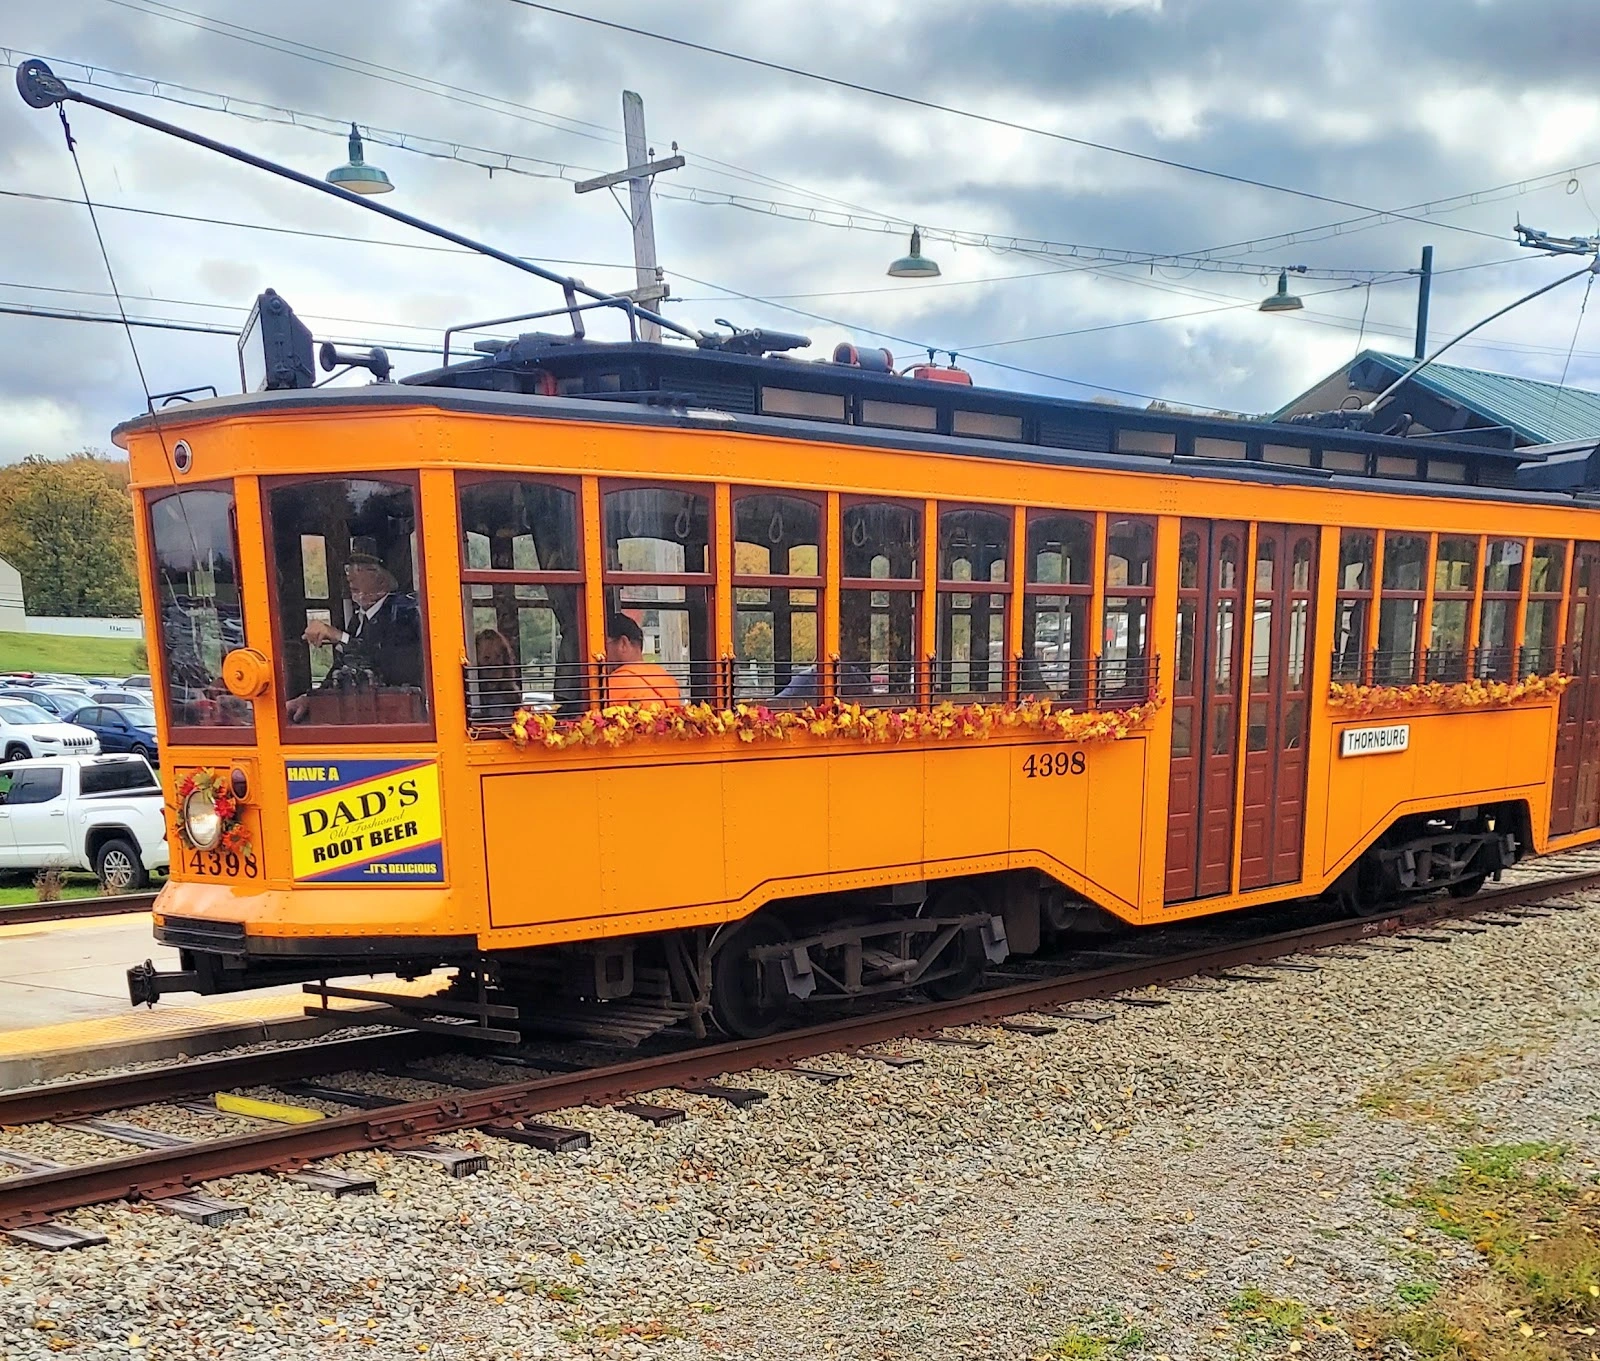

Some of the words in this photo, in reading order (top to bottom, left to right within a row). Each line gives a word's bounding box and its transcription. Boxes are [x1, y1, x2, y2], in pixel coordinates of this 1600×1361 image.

[1348, 728, 1405, 750] THORNBURG
[286, 767, 326, 781] HAVE
[328, 767, 340, 781] A
[1022, 751, 1086, 778] 4398
[299, 779, 419, 837] DAD'S
[330, 825, 349, 841] Old
[352, 809, 405, 833] Fashioned
[313, 835, 364, 863] ROOT
[369, 820, 418, 847] BEER
[189, 849, 258, 878] 4398
[388, 863, 437, 874] DELICIOUS
